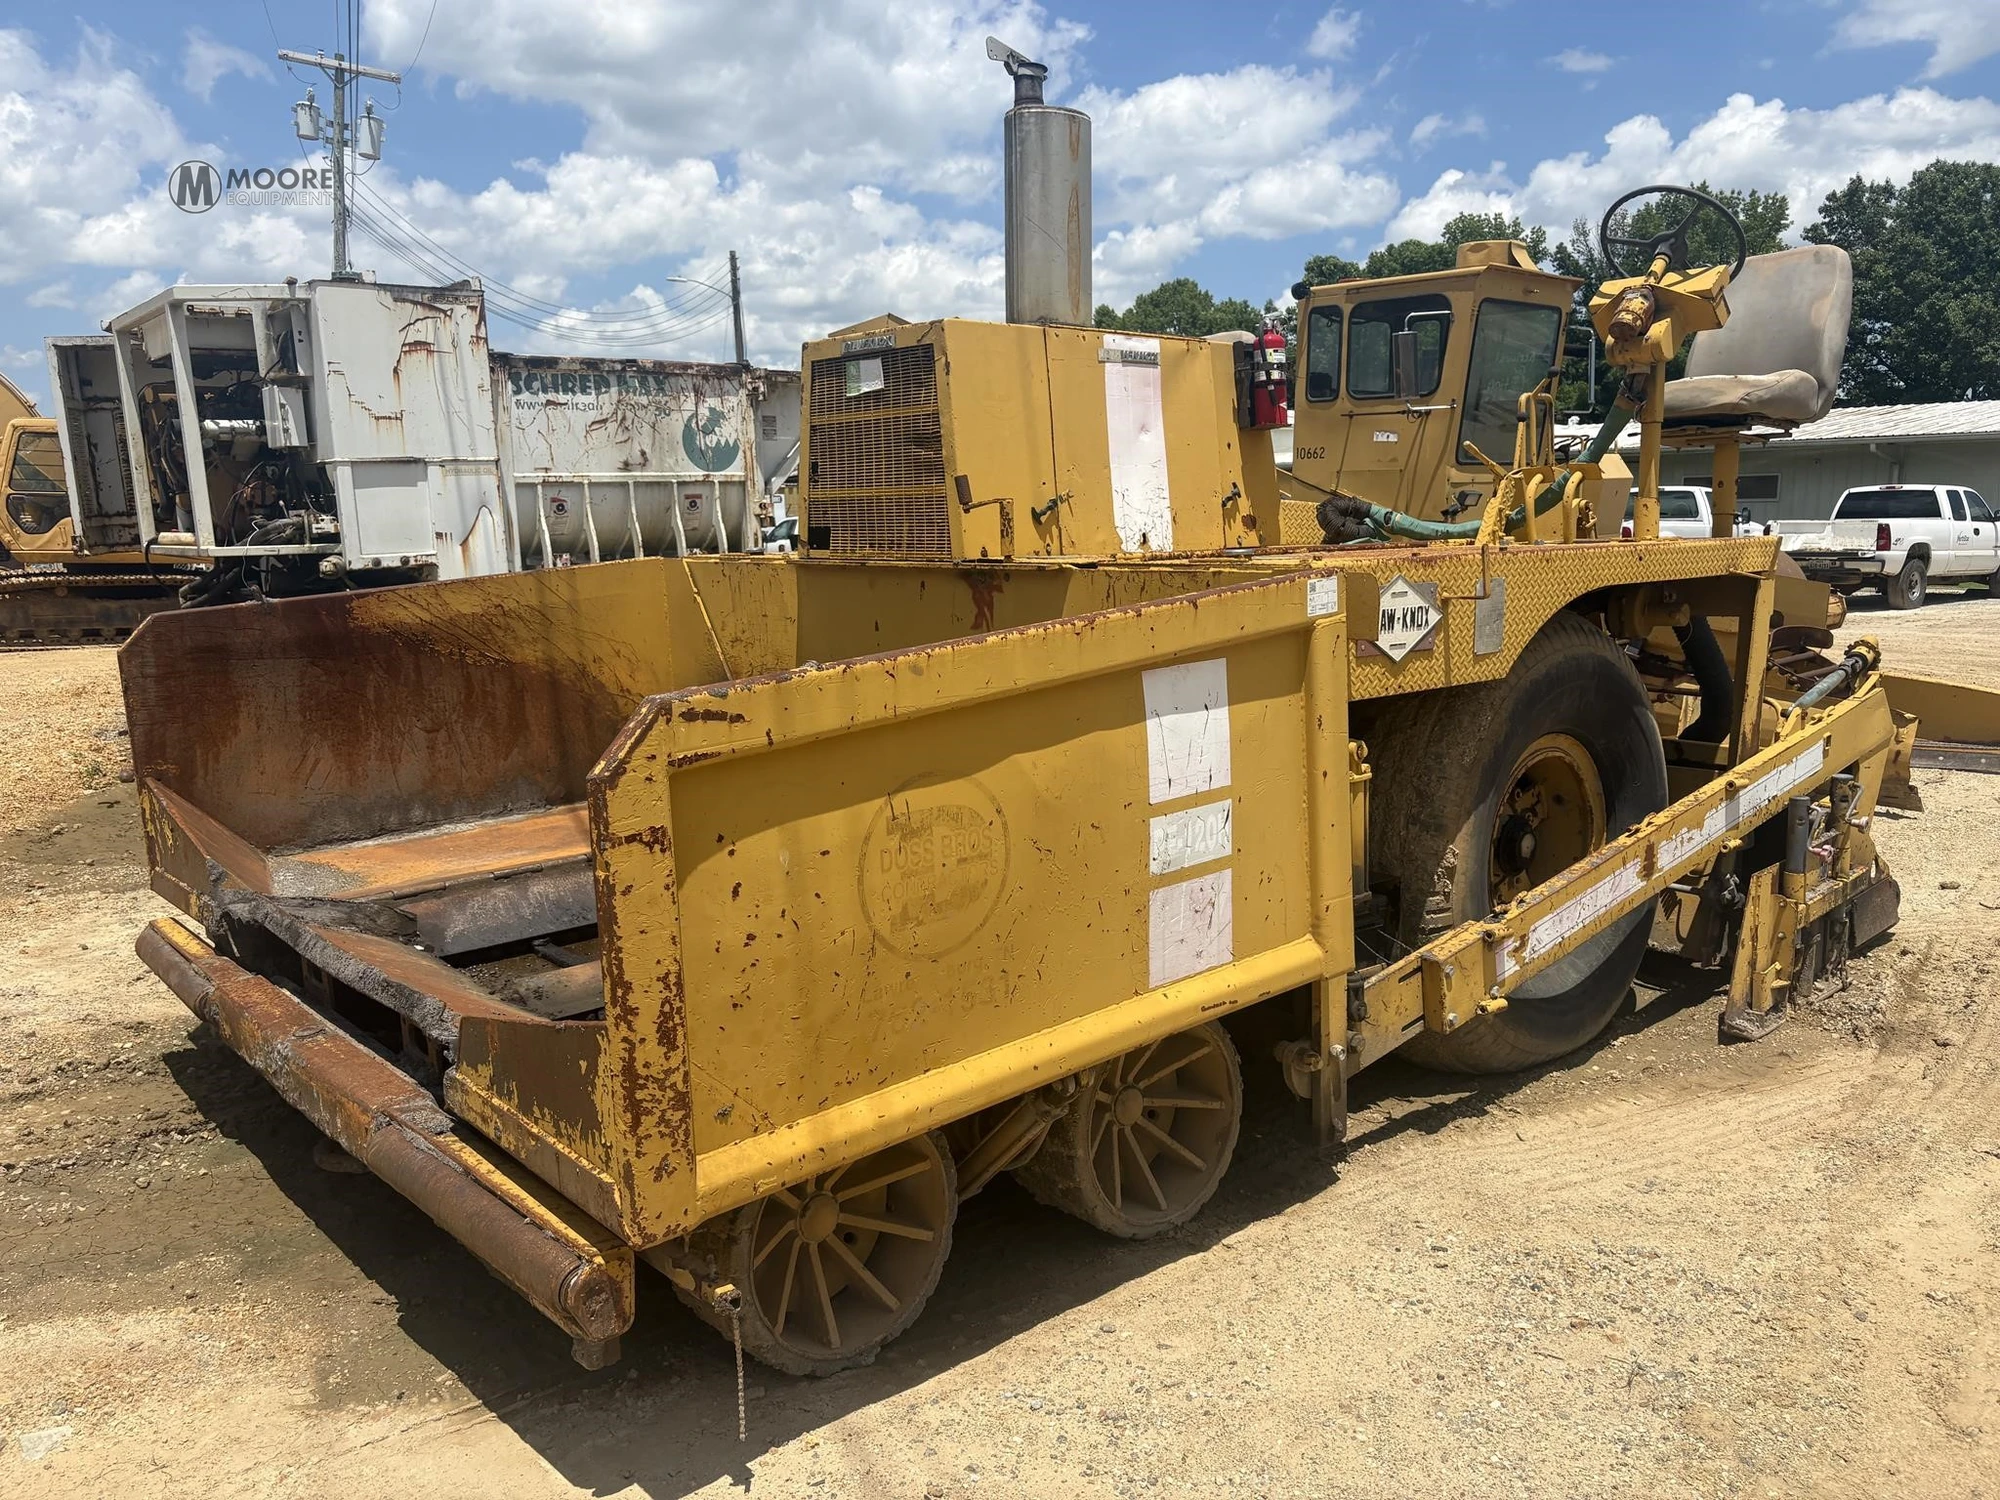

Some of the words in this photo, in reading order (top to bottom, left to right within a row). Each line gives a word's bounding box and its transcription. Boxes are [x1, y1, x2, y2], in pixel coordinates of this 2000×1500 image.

[1296, 446, 1326, 460] 10662
[1380, 605, 1430, 634] AW-KNOX
[880, 837, 935, 875] DOSS
